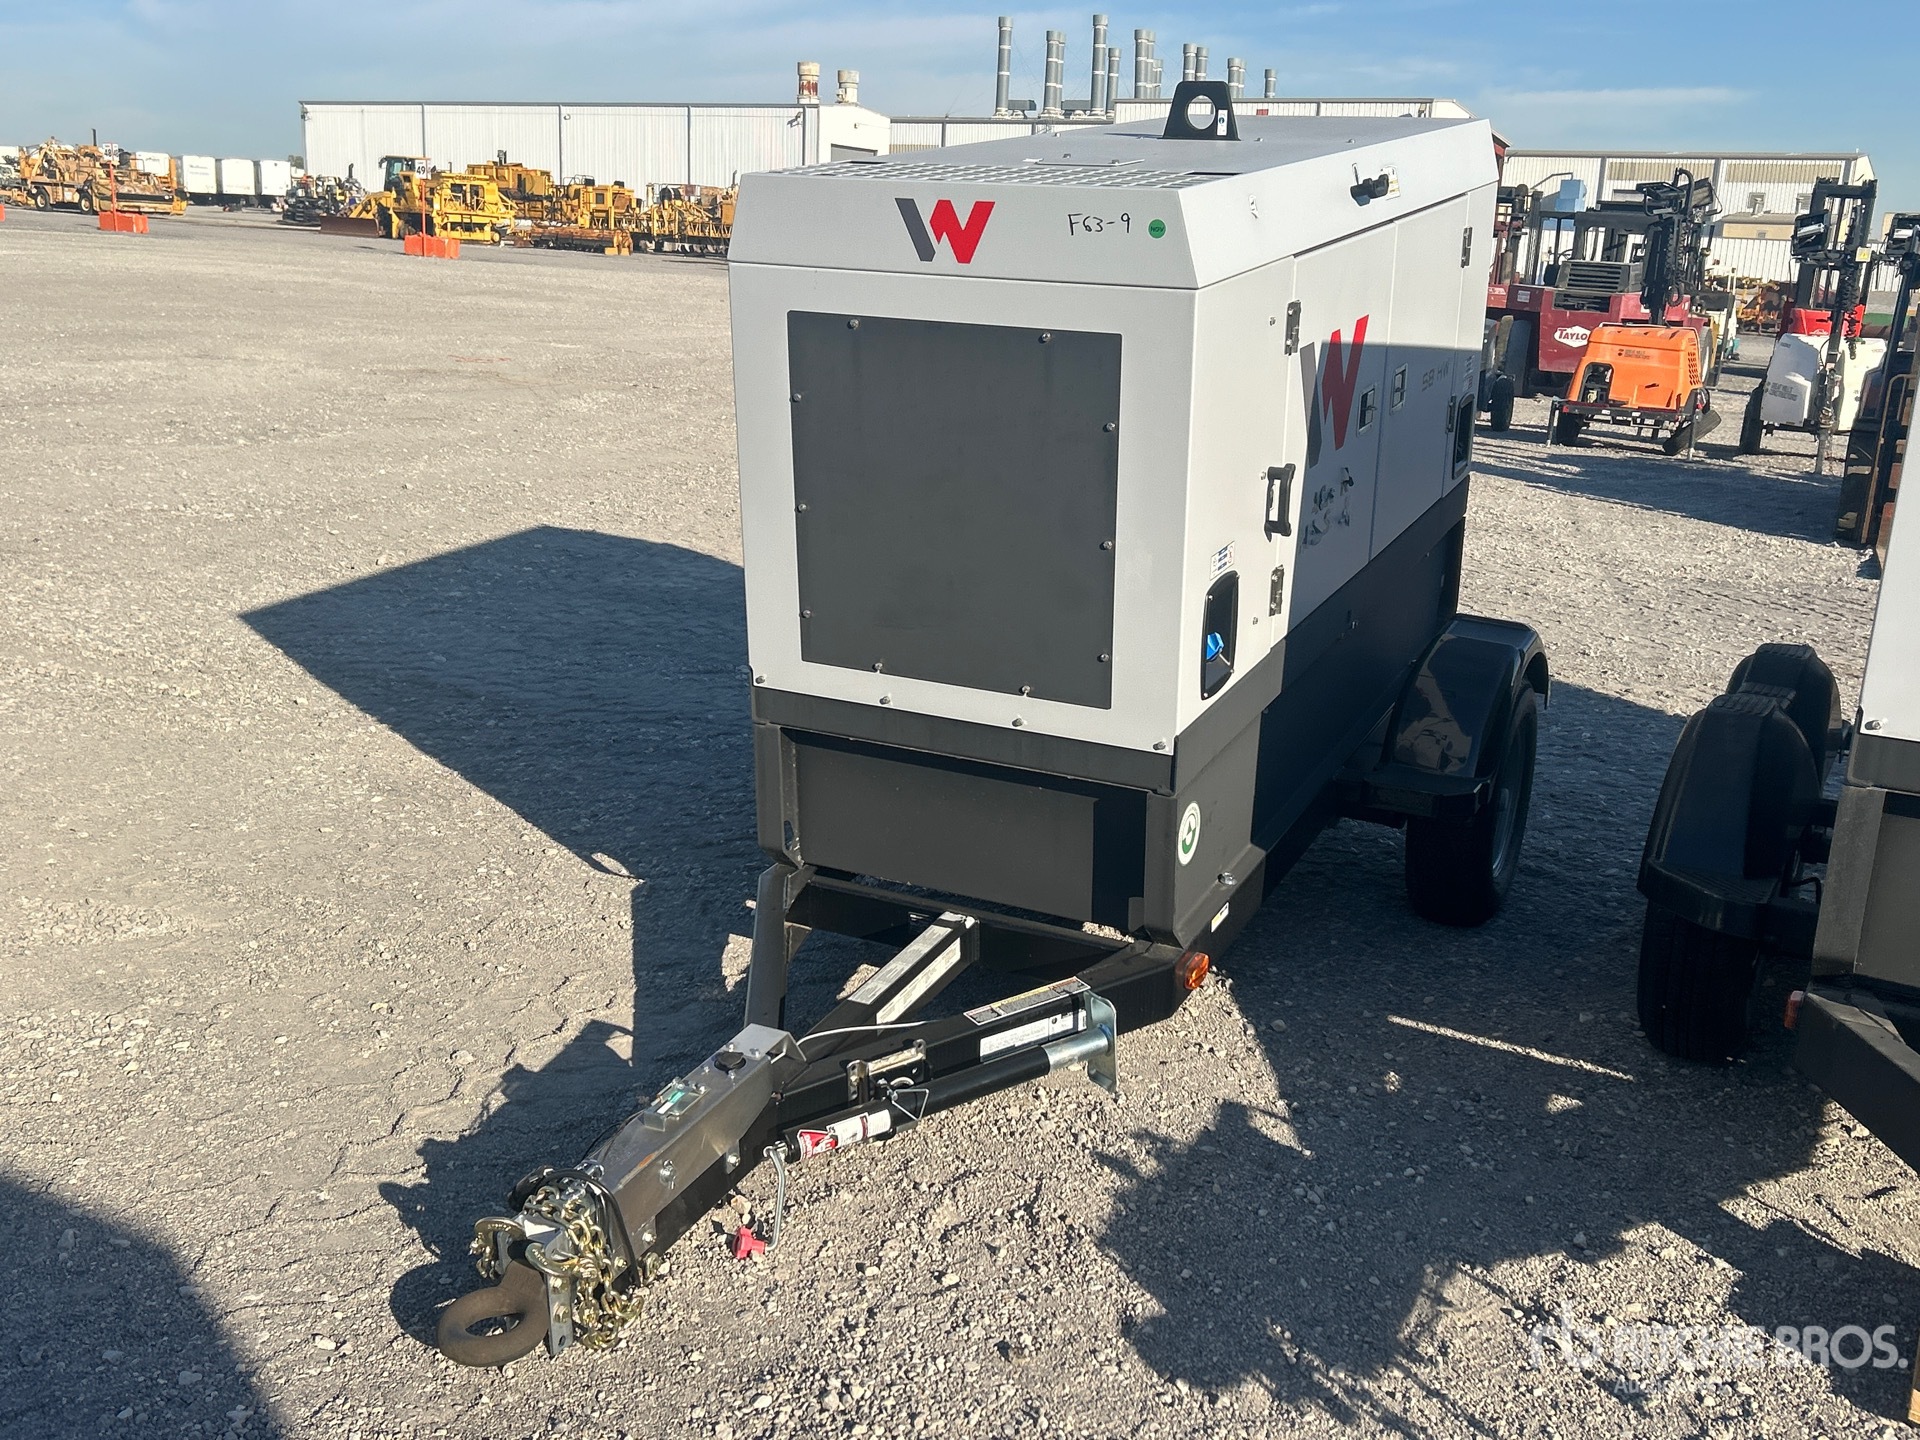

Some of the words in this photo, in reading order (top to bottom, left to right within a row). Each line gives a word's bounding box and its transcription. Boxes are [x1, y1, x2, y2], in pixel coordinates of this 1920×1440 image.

[416, 165, 426, 175] 49
[1067, 212, 1131, 236] F63-9
[1558, 328, 1588, 341] TAYLO
